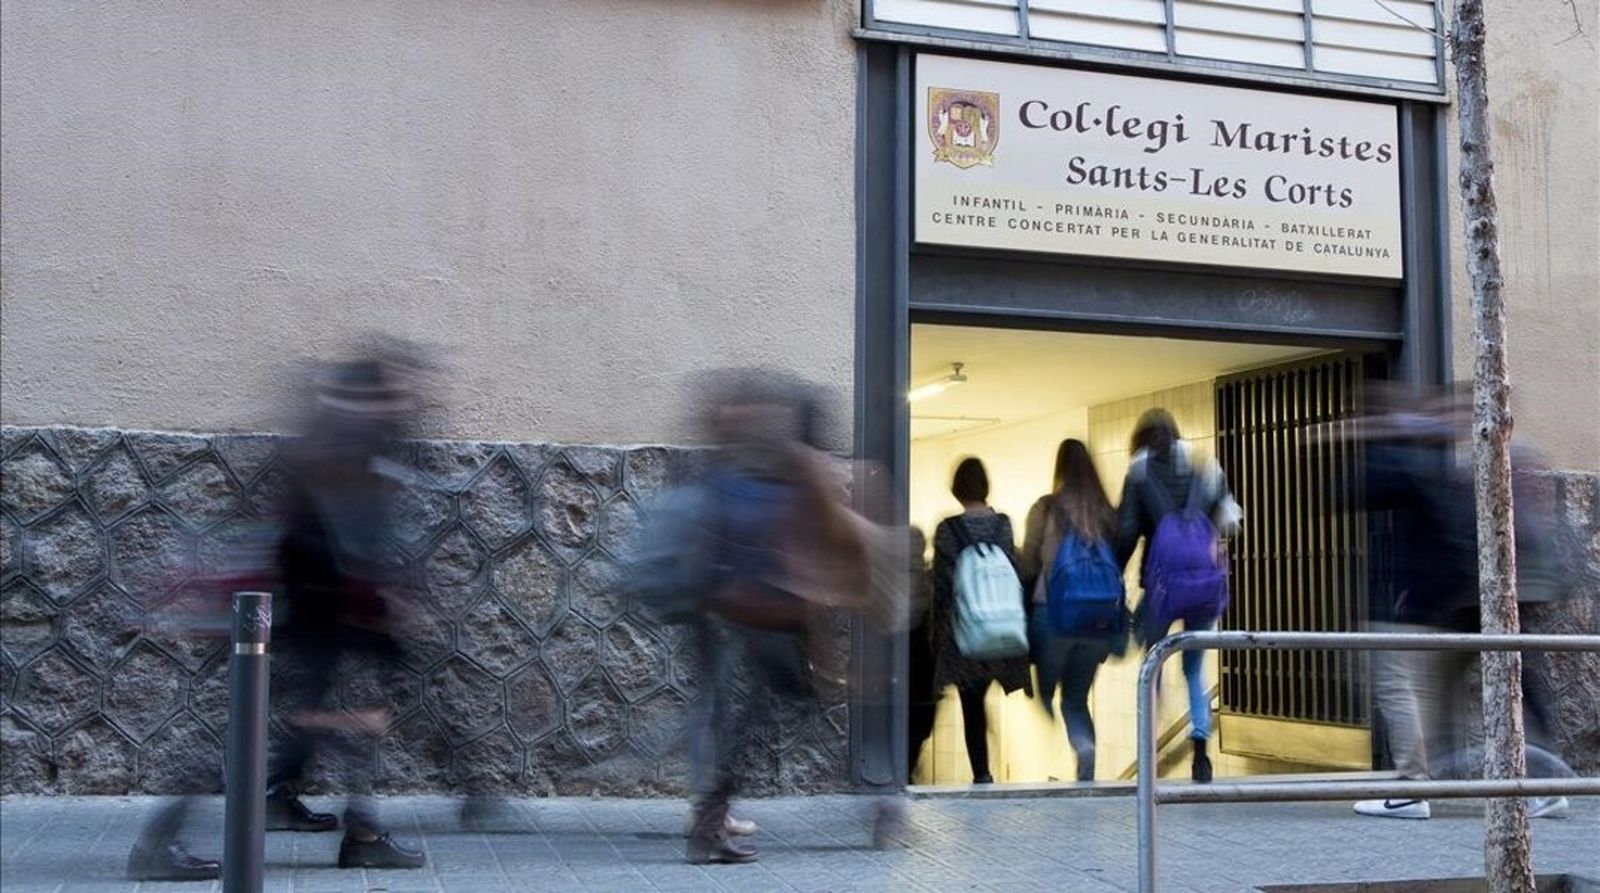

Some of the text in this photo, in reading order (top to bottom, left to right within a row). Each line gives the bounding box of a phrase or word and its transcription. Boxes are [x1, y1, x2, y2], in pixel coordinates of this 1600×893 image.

[1210, 119, 1392, 164] Maristes
[1264, 175, 1353, 208] Corts
[932, 212, 1391, 259] CENTRE CONCERTAT PER LA GENERALITAT DE CATALUNYA
[952, 195, 1027, 212] INFANTIL
[1055, 203, 1129, 220] PRIMÀRIA
[1156, 211, 1255, 231] SECUNDÀRIA
[1281, 222, 1372, 240] BATXILLERAT
